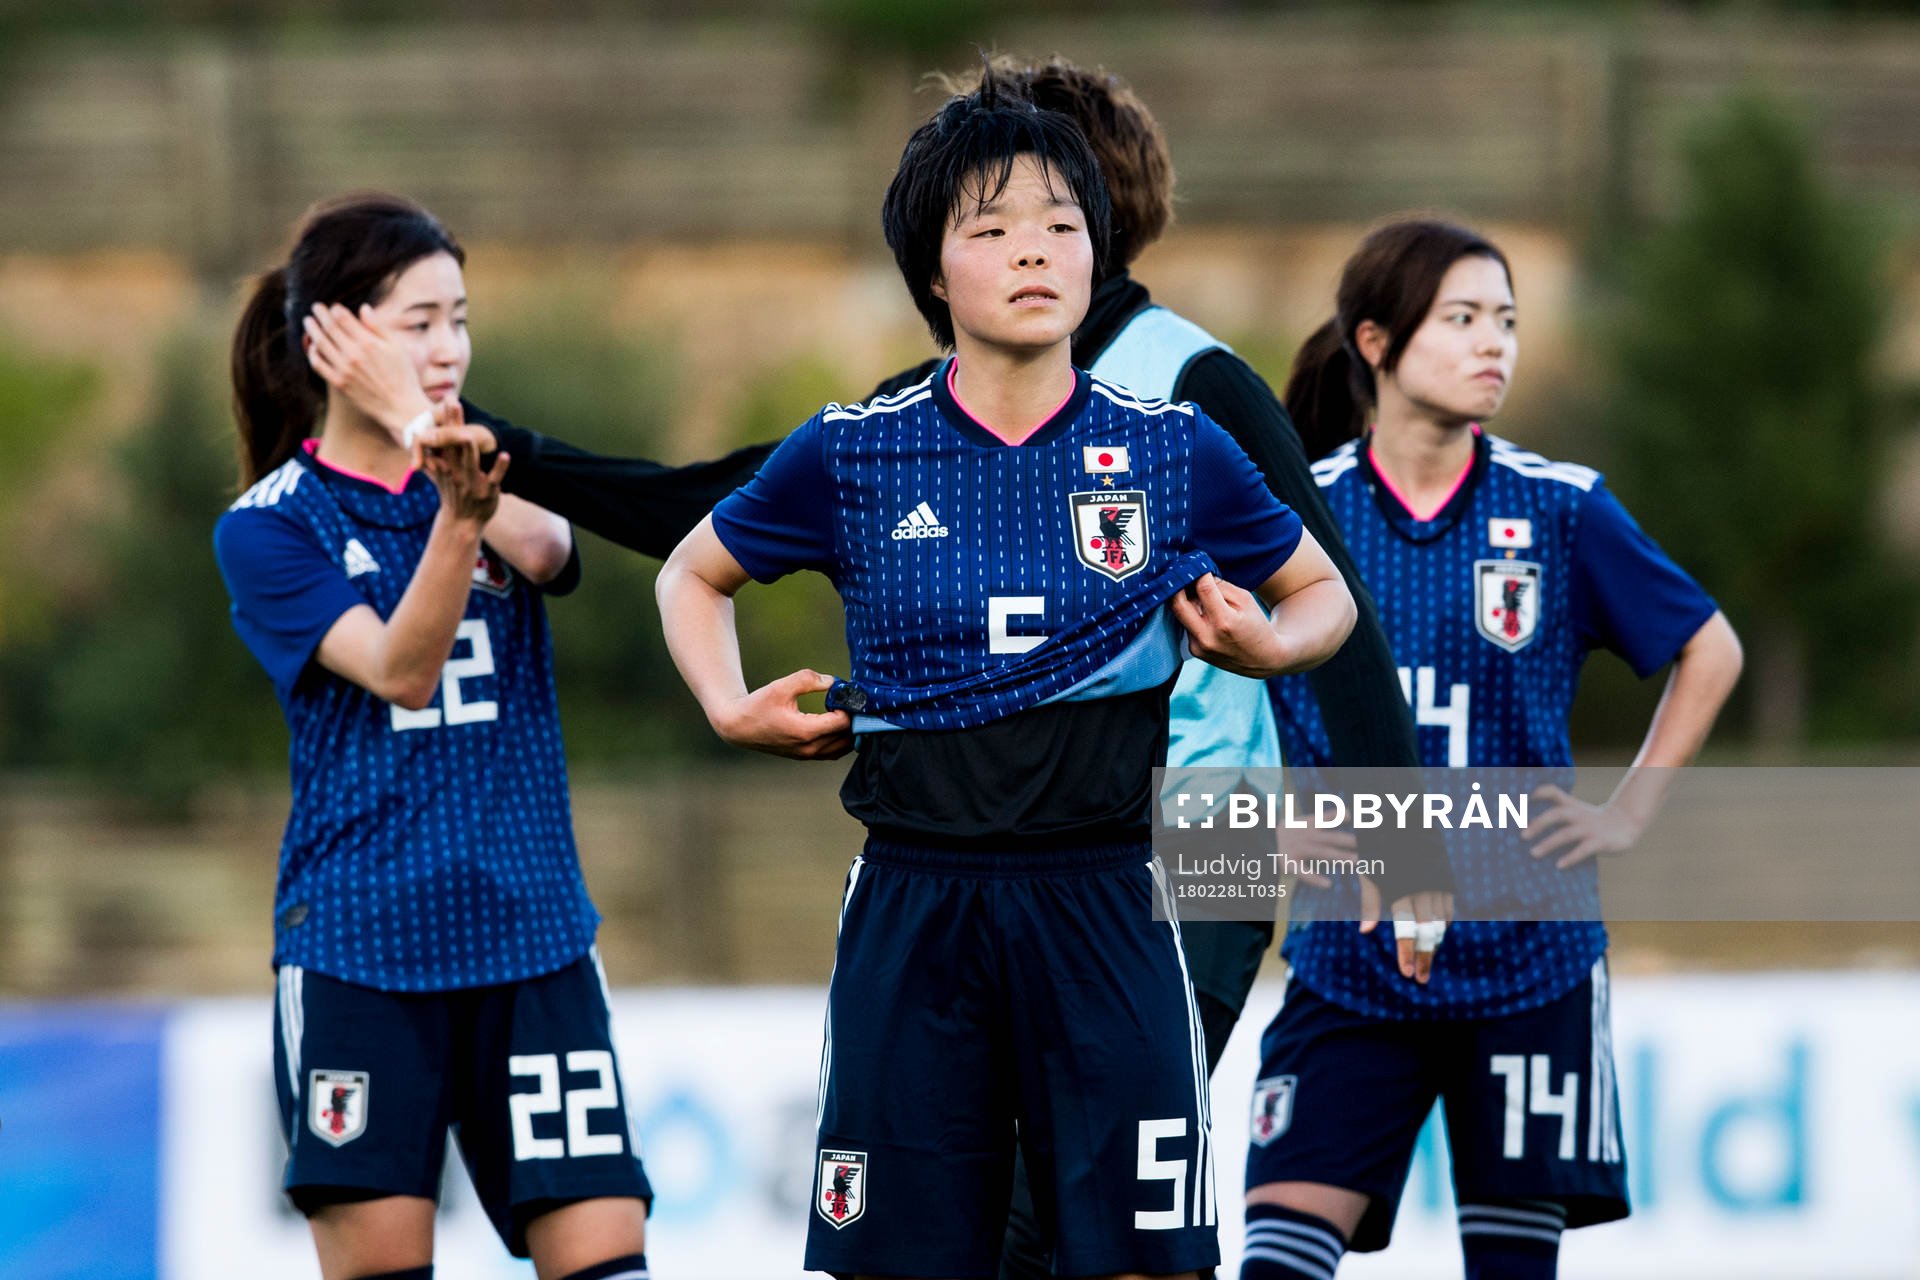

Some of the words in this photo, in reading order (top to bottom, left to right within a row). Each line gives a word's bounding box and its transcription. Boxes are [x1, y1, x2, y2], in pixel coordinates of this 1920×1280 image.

[1089, 494, 1128, 503] JAPAN
[891, 524, 949, 541] adidas
[1100, 550, 1130, 564] JFA
[508, 1050, 623, 1161] 22
[1490, 1054, 1578, 1160] 14
[830, 1153, 857, 1162] JAPAN
[1134, 1117, 1187, 1230] 5
[828, 1202, 850, 1215] JFA
